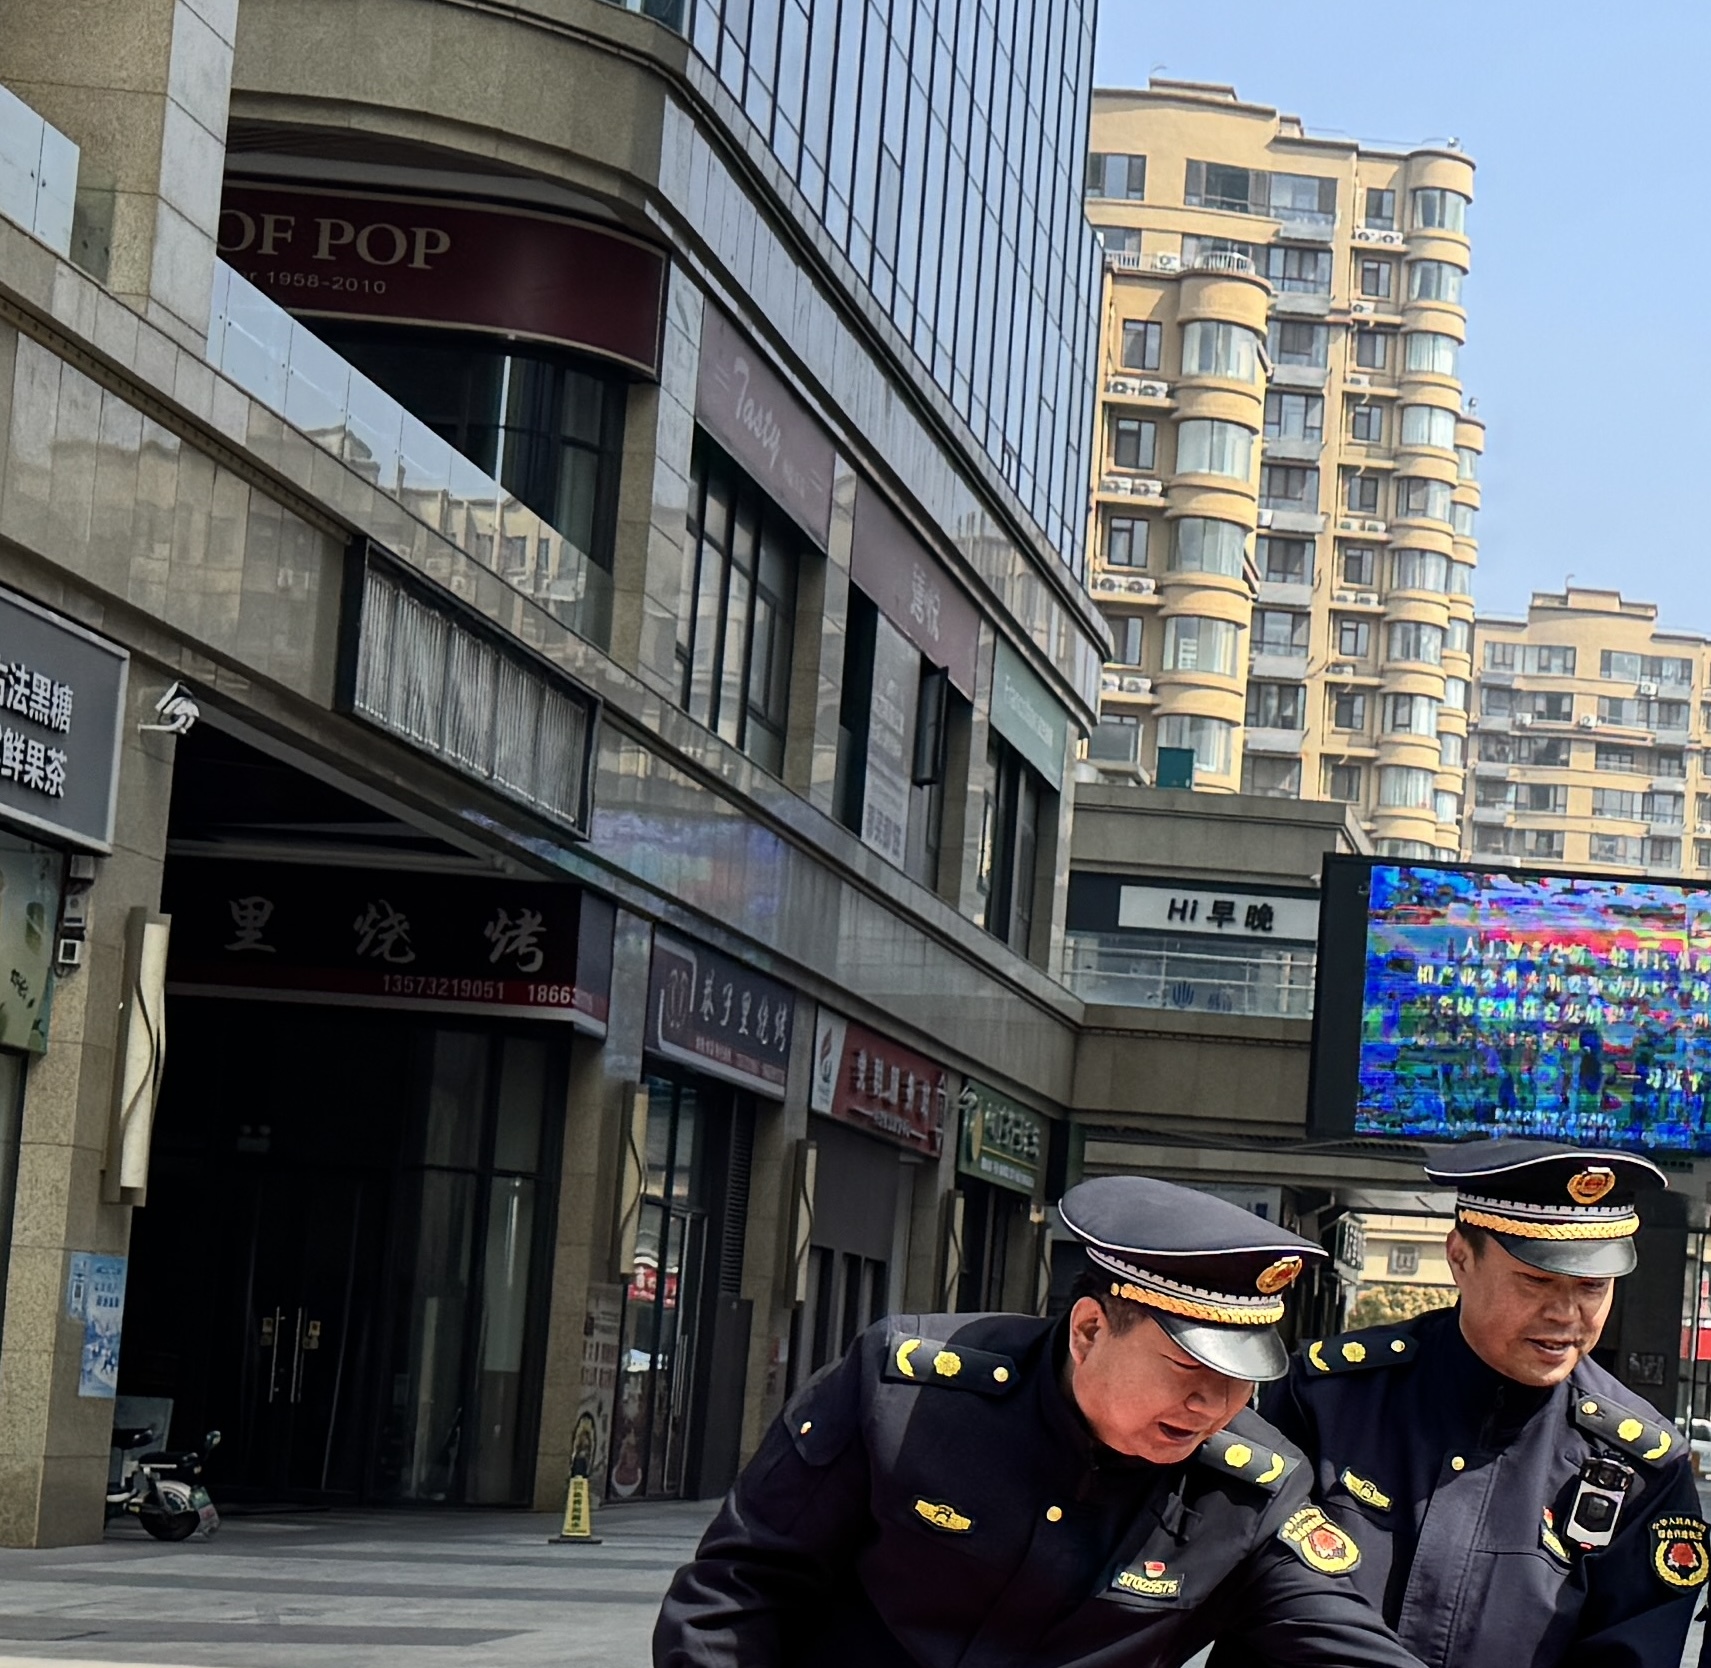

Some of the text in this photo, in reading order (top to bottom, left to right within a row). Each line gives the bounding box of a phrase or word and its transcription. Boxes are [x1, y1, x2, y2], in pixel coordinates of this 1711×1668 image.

[312, 217, 451, 270] POP
[266, 271, 386, 295] 1958-2010
[0, 726, 67, 798] 鲜果茶
